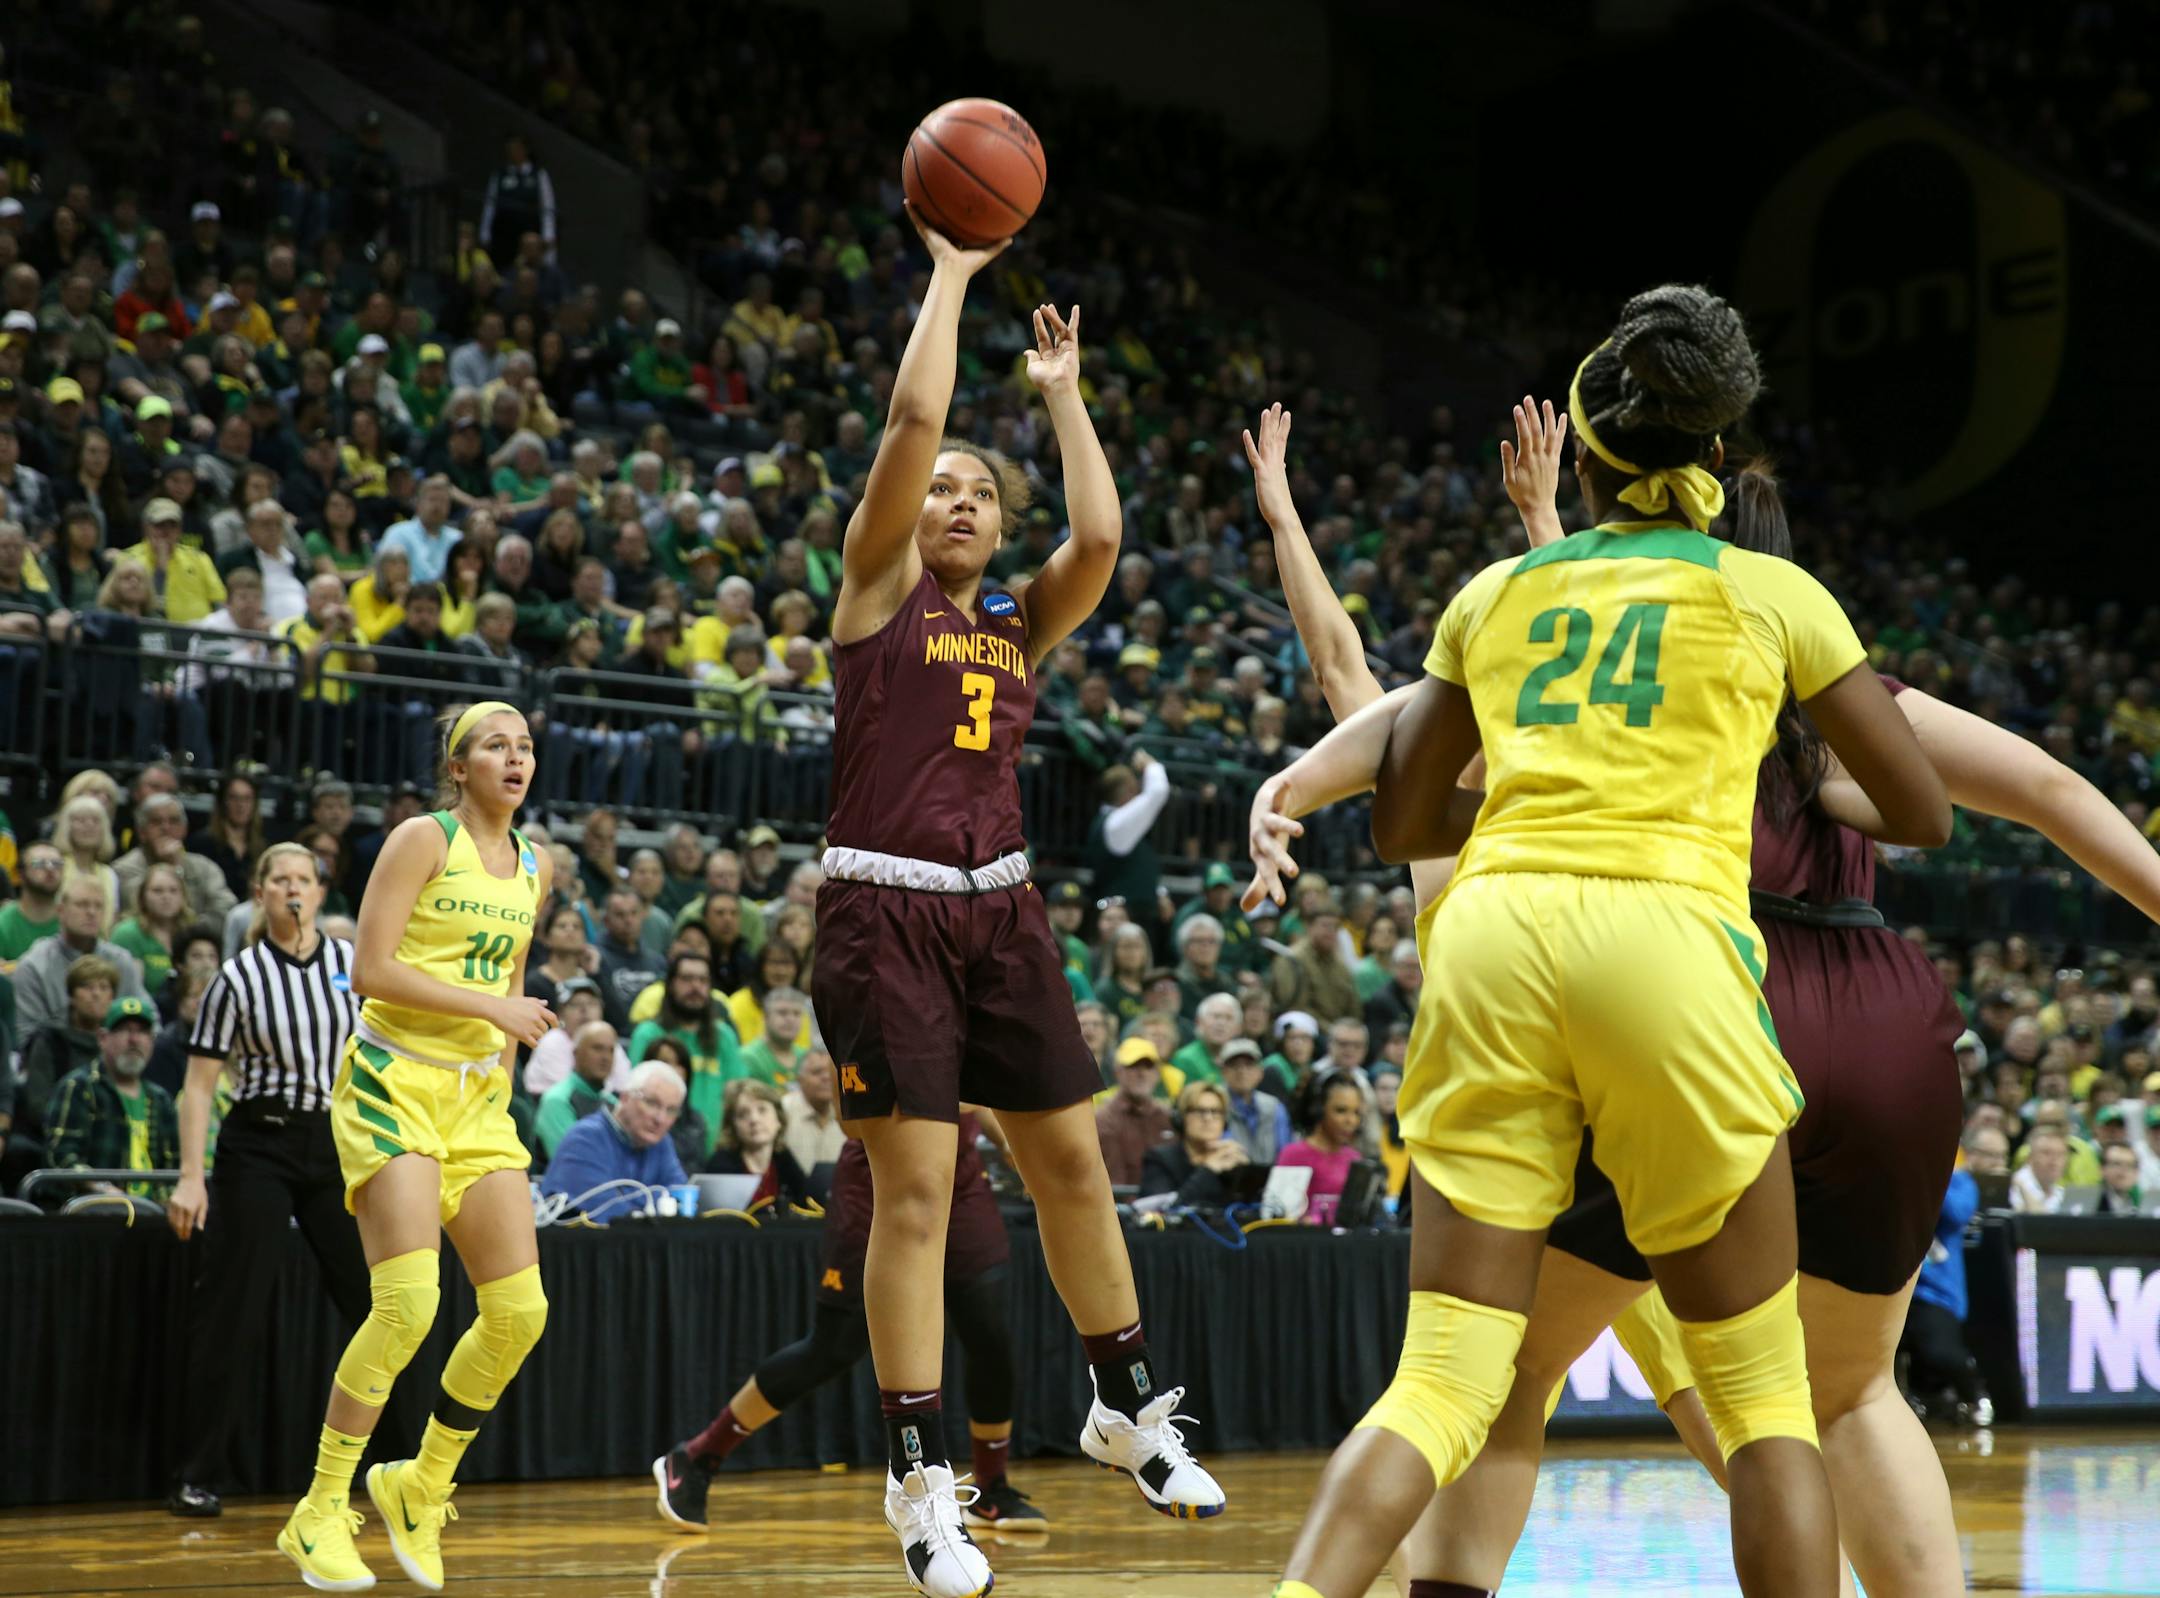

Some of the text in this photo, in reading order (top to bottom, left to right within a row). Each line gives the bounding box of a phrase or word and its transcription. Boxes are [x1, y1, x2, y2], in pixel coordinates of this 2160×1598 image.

[925, 633, 1027, 688] MINNESOTA
[1515, 604, 1669, 728] 24
[954, 672, 996, 751] 3
[463, 931, 514, 982] 10
